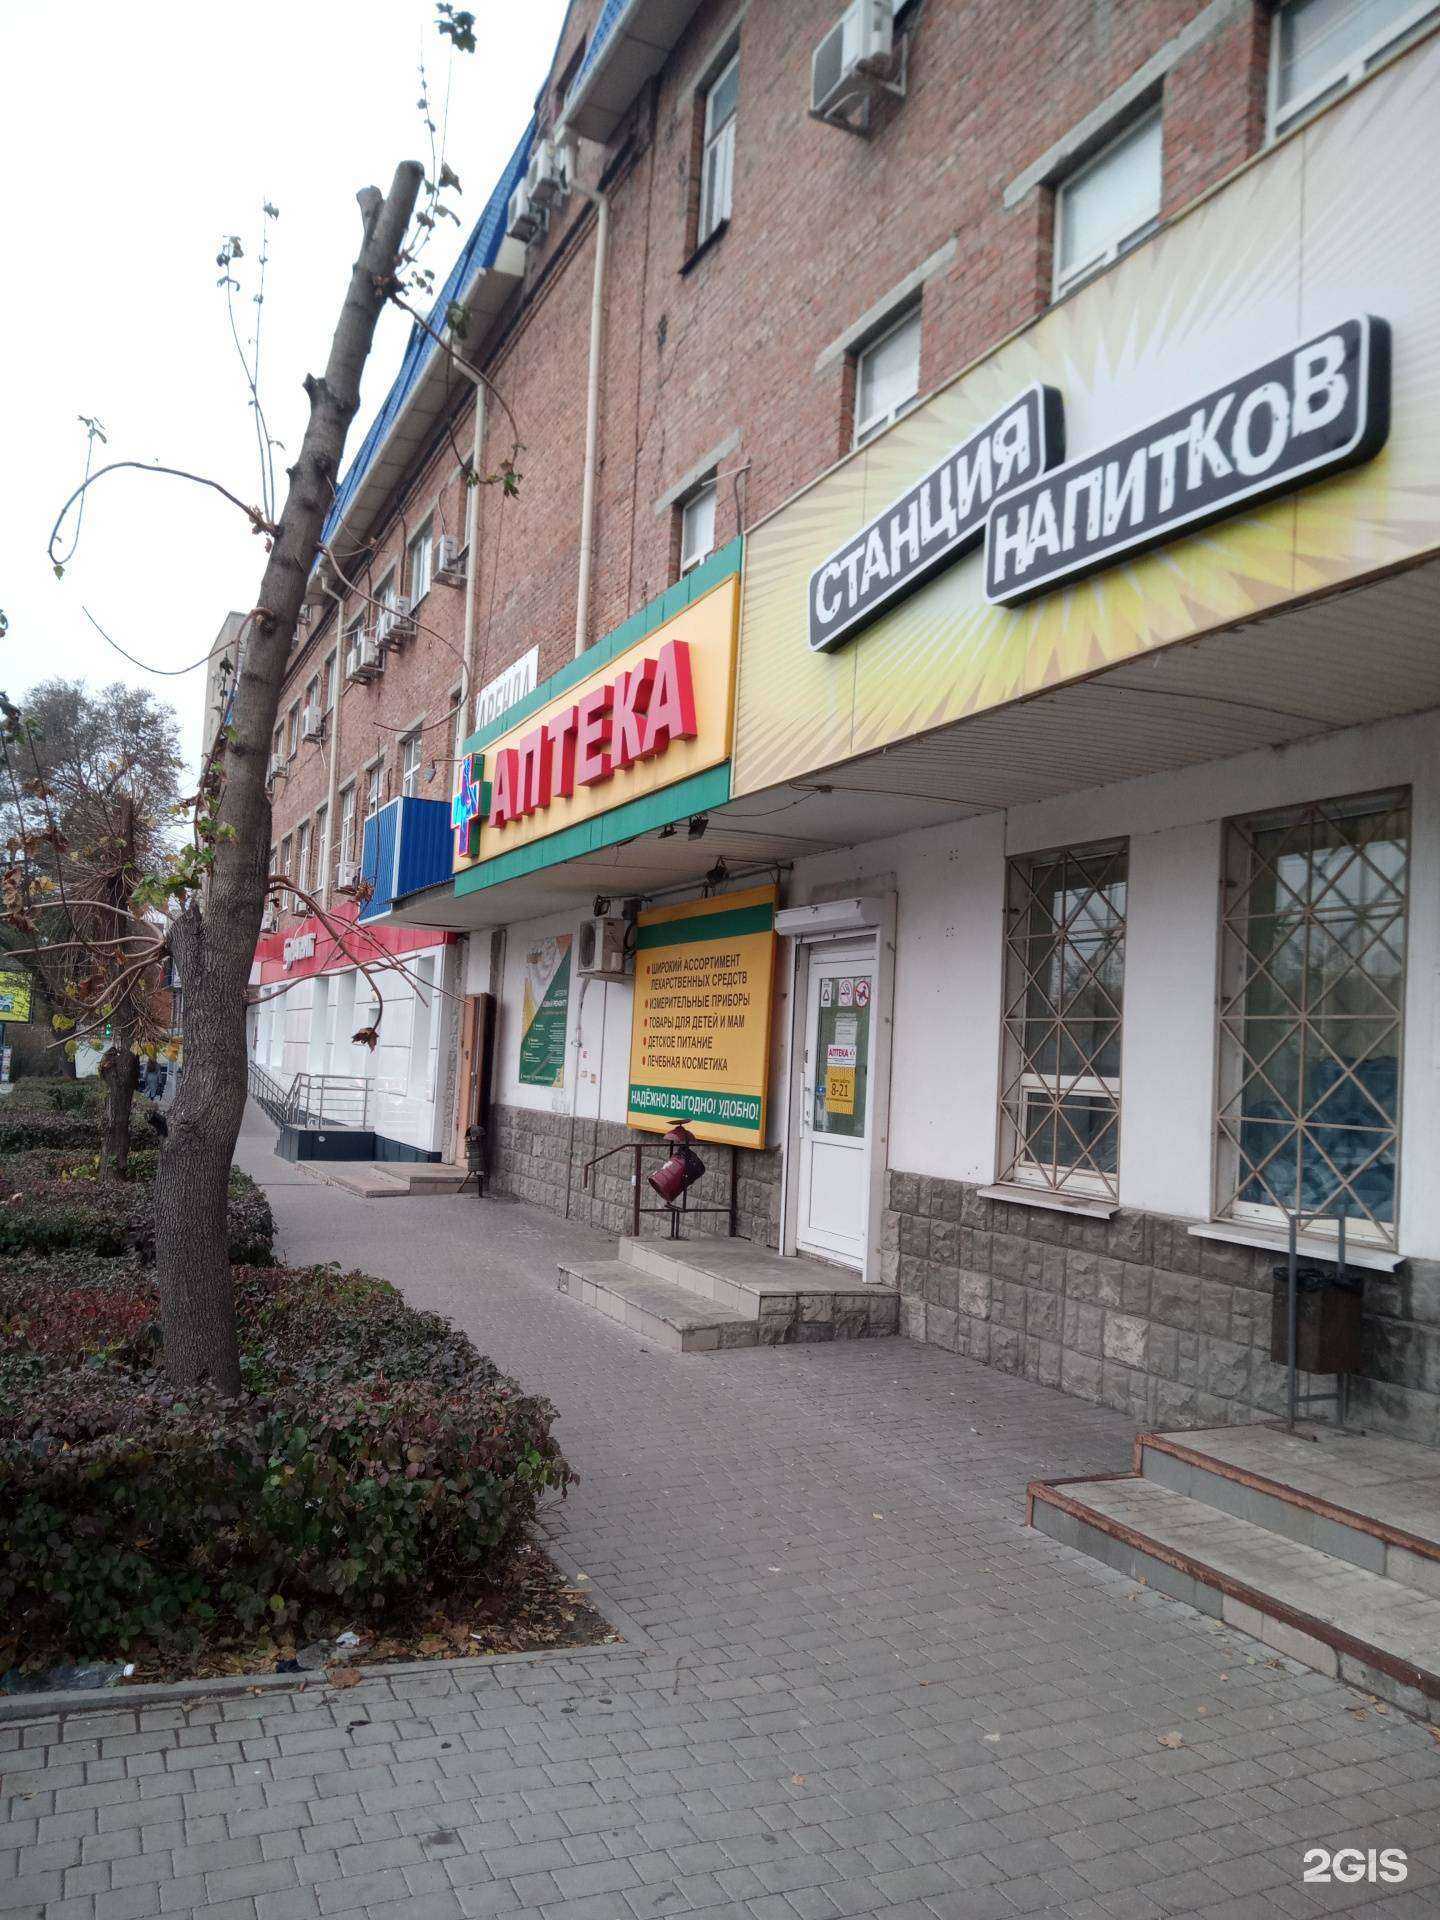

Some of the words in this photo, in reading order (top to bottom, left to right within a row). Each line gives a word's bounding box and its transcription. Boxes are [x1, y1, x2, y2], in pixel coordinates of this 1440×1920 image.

[992, 334, 1351, 588] НАПИТКОВ
[814, 403, 1031, 625] СТАНЦИЯ
[488, 639, 697, 829] АПТЕКА
[651, 957, 682, 975] ШИРОКИЙ
[684, 953, 741, 972] АССОРТИМЕНТ
[651, 974, 710, 991] ЛЕКАРСТВЕННЫХ
[711, 971, 748, 988] СРЕДСТВ
[649, 994, 710, 1010] ИЗМЕРИТЕЛЬНЫЕ
[711, 992, 750, 1008] ПРИБОРЫ
[649, 1016, 674, 1029] ТОВАРЫ
[675, 1016, 690, 1030] ДЛЯ
[692, 1012, 718, 1030] ДЕТЕЙ
[720, 1015, 726, 1029] И
[727, 1014, 745, 1029] МАМ
[648, 1036, 675, 1050] ДЕТСКОЕ
[676, 1036, 713, 1050] ПИТАНИЕ
[828, 1048, 848, 1057] АПТЕКА
[647, 1054, 681, 1069] ЛЕЧЕБНАЯ
[682, 1056, 728, 1072] КОСМЕТИКА
[831, 1083, 848, 1097] 8-21
[631, 1088, 669, 1109] НАДЁЖНО!
[670, 1094, 717, 1115] ВЫГОДНО!
[718, 1099, 759, 1121] УДОБНО!
